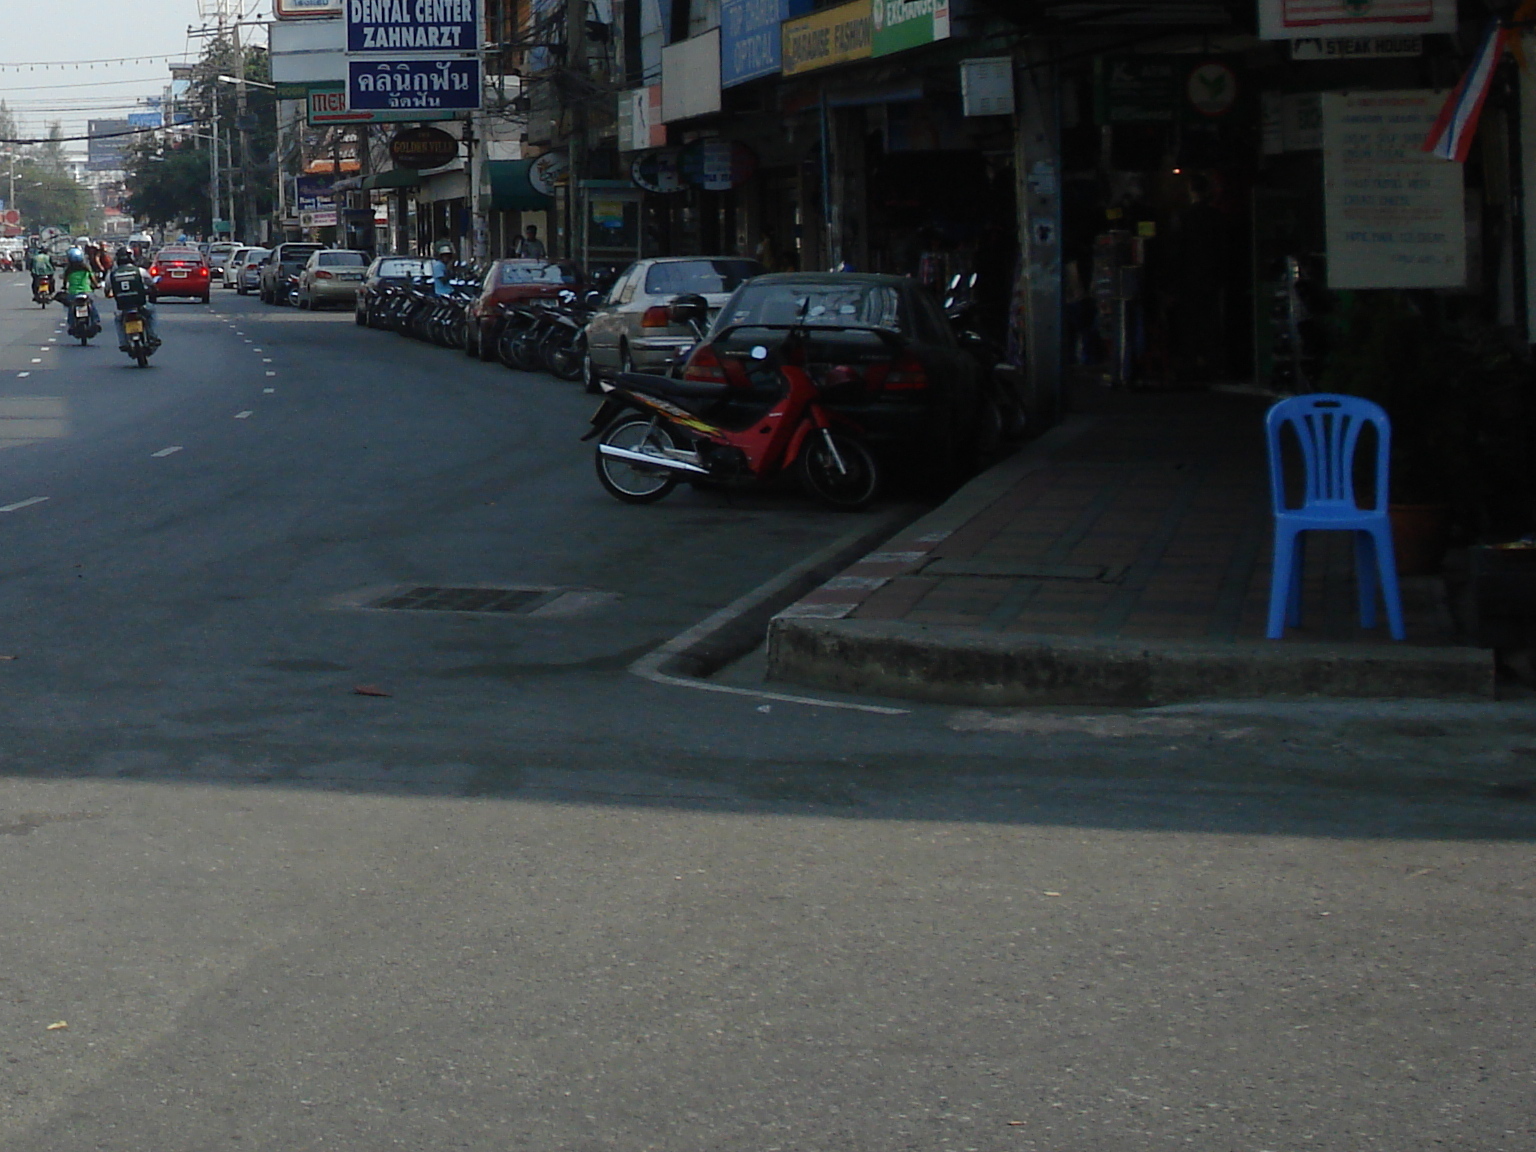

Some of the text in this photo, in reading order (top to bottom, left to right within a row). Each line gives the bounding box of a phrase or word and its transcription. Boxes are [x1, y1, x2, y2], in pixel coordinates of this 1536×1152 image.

[363, 26, 462, 48] ZAHNARZT
[358, 61, 469, 91] คลินิกฟัน
